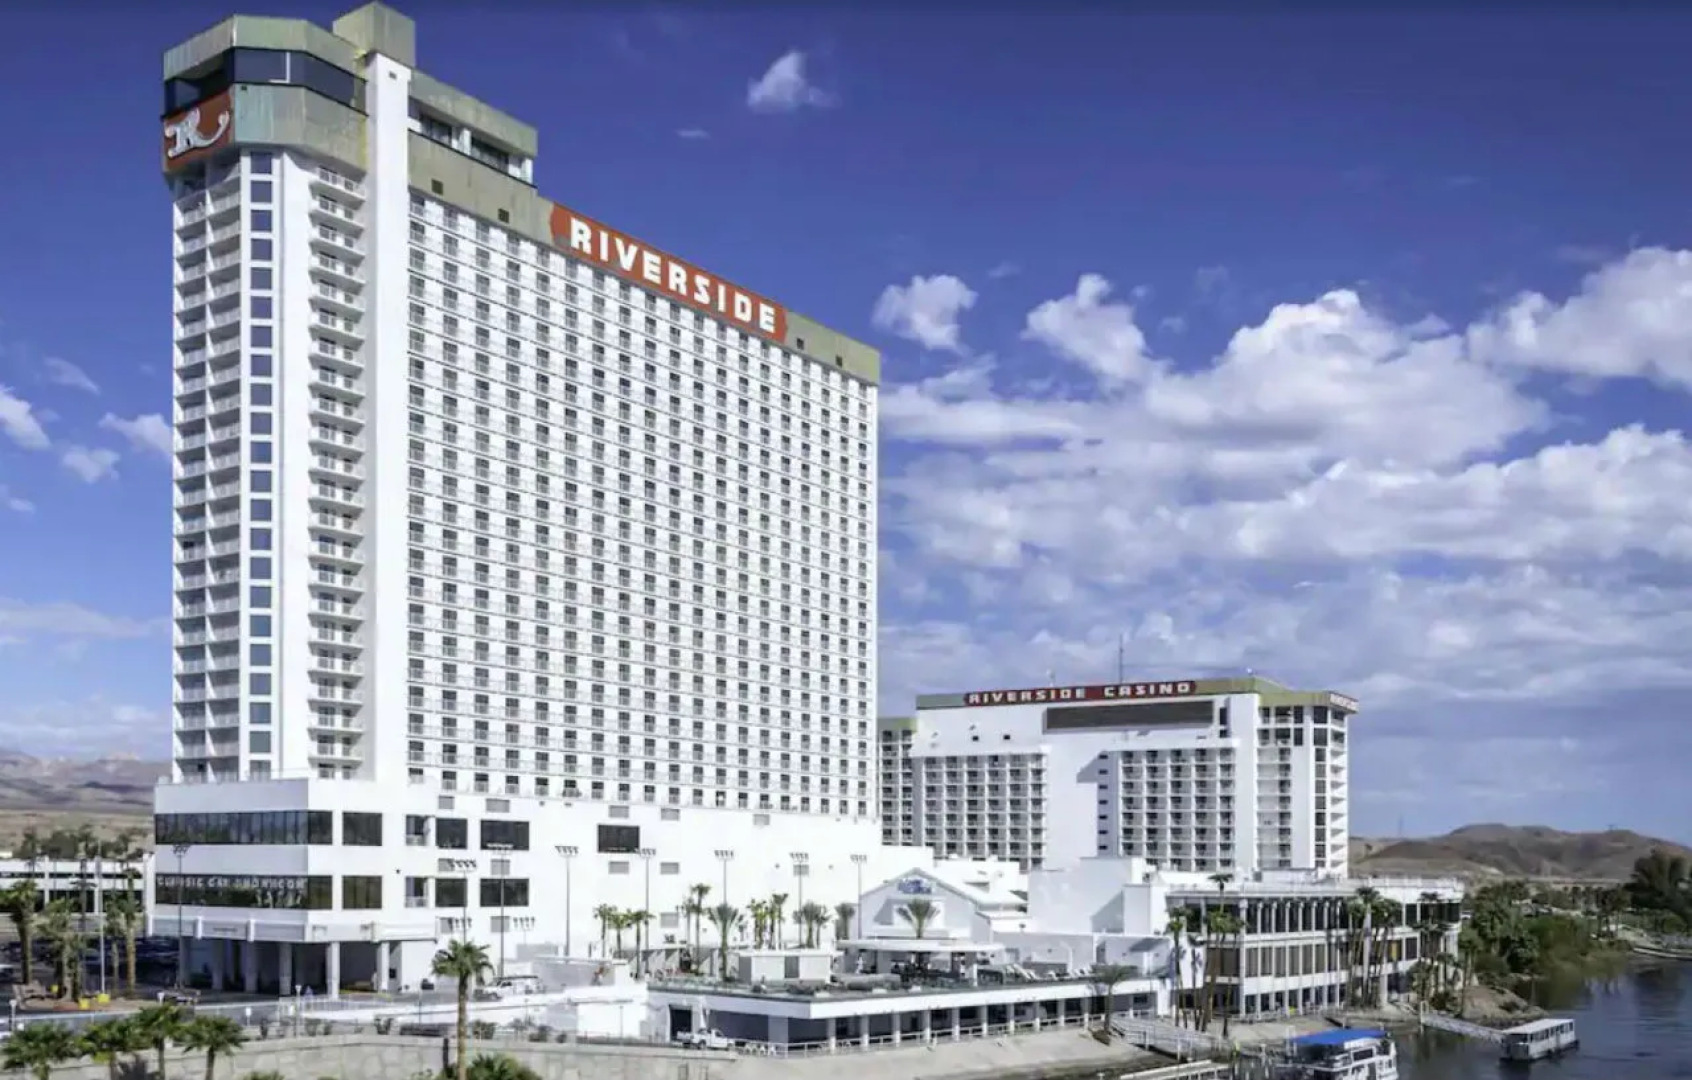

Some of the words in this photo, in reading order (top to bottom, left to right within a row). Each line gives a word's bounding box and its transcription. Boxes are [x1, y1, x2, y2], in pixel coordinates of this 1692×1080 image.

[570, 217, 776, 333] RIVERSIDE
[968, 688, 1086, 704] RIVERSIDE
[1104, 682, 1191, 698] CASINO
